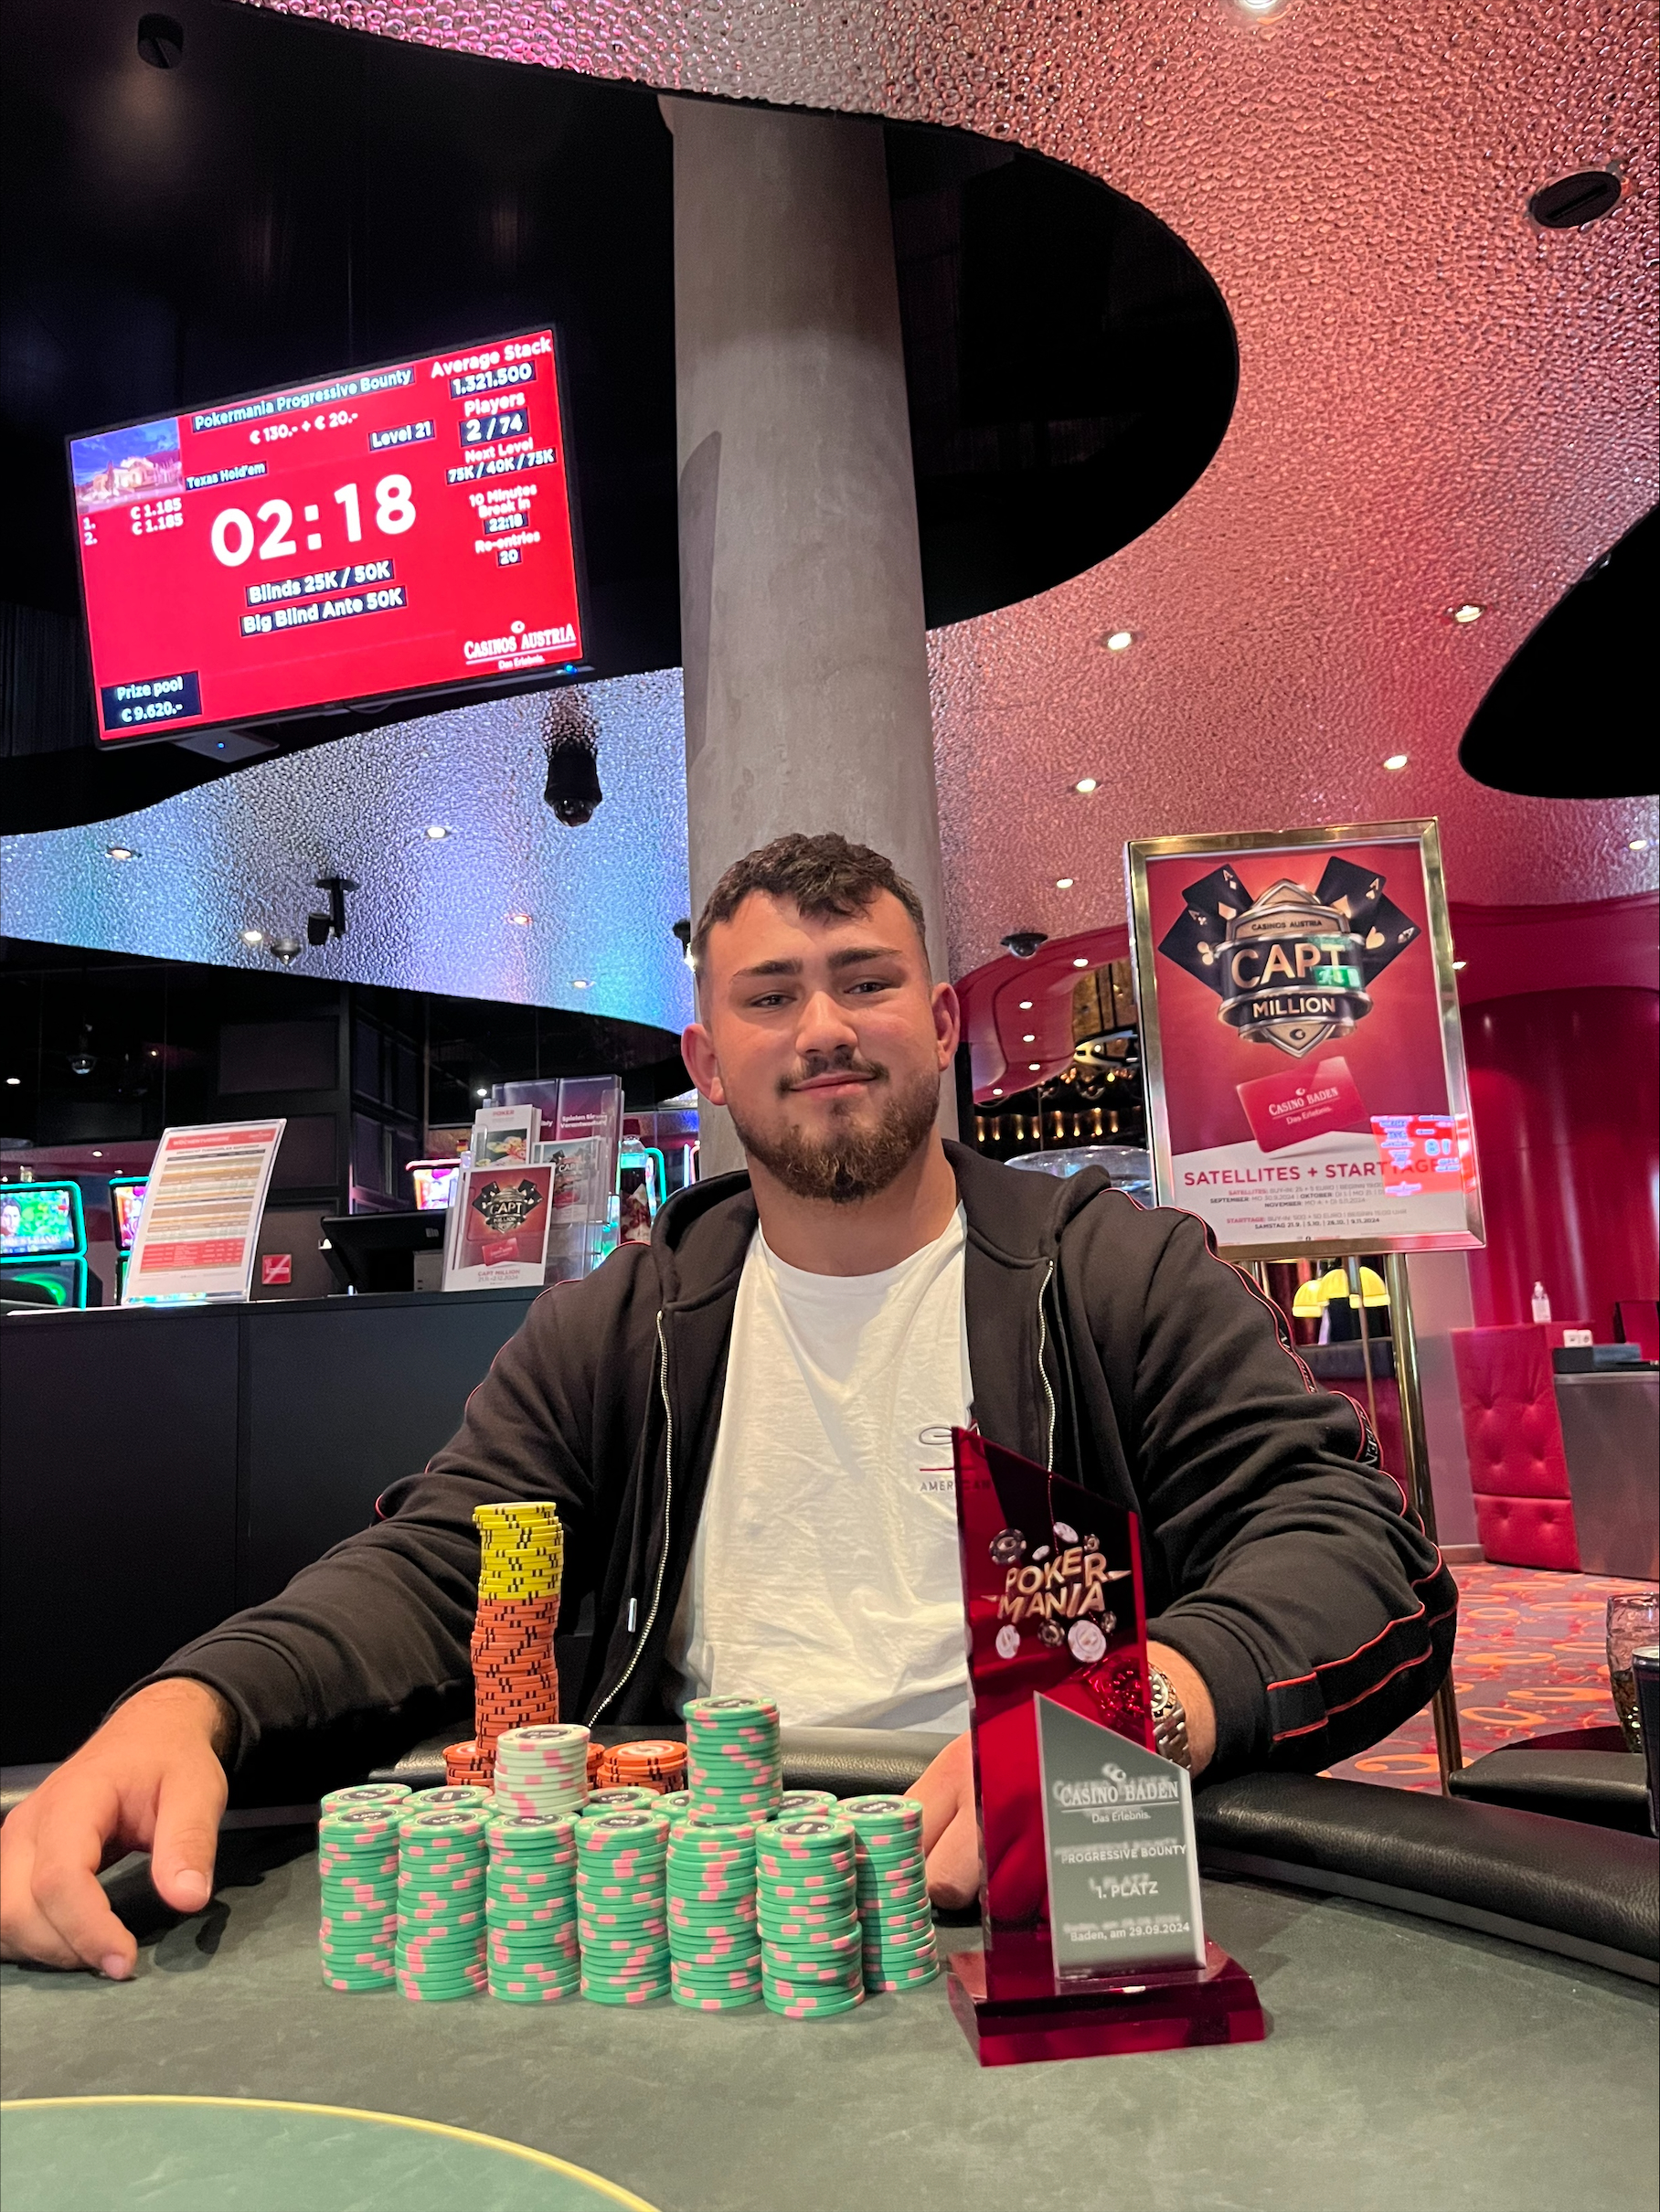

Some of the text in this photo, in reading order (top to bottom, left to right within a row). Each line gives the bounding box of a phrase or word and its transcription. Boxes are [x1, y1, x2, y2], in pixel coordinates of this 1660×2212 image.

[431, 335, 553, 379] Average Stack
[452, 363, 533, 396] 1.321.500
[194, 368, 412, 431] Pokermania Progressive Bounty
[464, 392, 526, 418] Players
[263, 424, 299, 442] 130.-
[302, 420, 312, 433] +
[329, 411, 358, 429] 20.-
[372, 421, 432, 449] Level 21
[466, 414, 524, 442] 2 / 74
[464, 437, 534, 464] Next Level
[186, 461, 266, 490] Texas Hold'em
[448, 464, 476, 484] 75K
[486, 457, 516, 476] 40K
[527, 448, 555, 469] 75K
[469, 484, 537, 507] 10 Minutes
[82, 517, 96, 530] 1.
[144, 496, 182, 517] 1.185
[210, 473, 417, 568] 02:18
[478, 500, 516, 519] Break
[84, 532, 98, 546] 2.
[145, 513, 184, 533] 1.185
[474, 530, 541, 554] Re-entries
[499, 548, 519, 566] 20
[249, 559, 392, 604] Blinds 25K / 50K
[242, 588, 404, 634] Big Blind Ante 50K
[463, 622, 577, 660] CASINOS AUSTRIA
[117, 675, 184, 702] Prize pool
[133, 700, 184, 721] 9.620.-
[1251, 919, 1323, 931] CASINOS AUSTRIA
[1231, 942, 1346, 989] CAPT
[1251, 996, 1336, 1019] MILLION
[1268, 1086, 1339, 1117] CASINO BADEN
[1285, 1115, 1302, 1126] Das
[1184, 1166, 1301, 1186] SATELLITES
[1307, 1167, 1318, 1178] +
[489, 1202, 522, 1216] CAPT
[1006, 1546, 1110, 1595] POKER
[996, 1580, 1106, 1624] MANIA
[1060, 1781, 1179, 1807] CASINO BADEN
[1091, 1809, 1152, 1824] Das Erlebnis.
[1061, 1844, 1187, 1865] PROGRESSIVE BOUNTY
[1095, 1880, 1159, 1899] 1. PLATZ
[1070, 1921, 1190, 1941] Baden, am 29.09.2024
